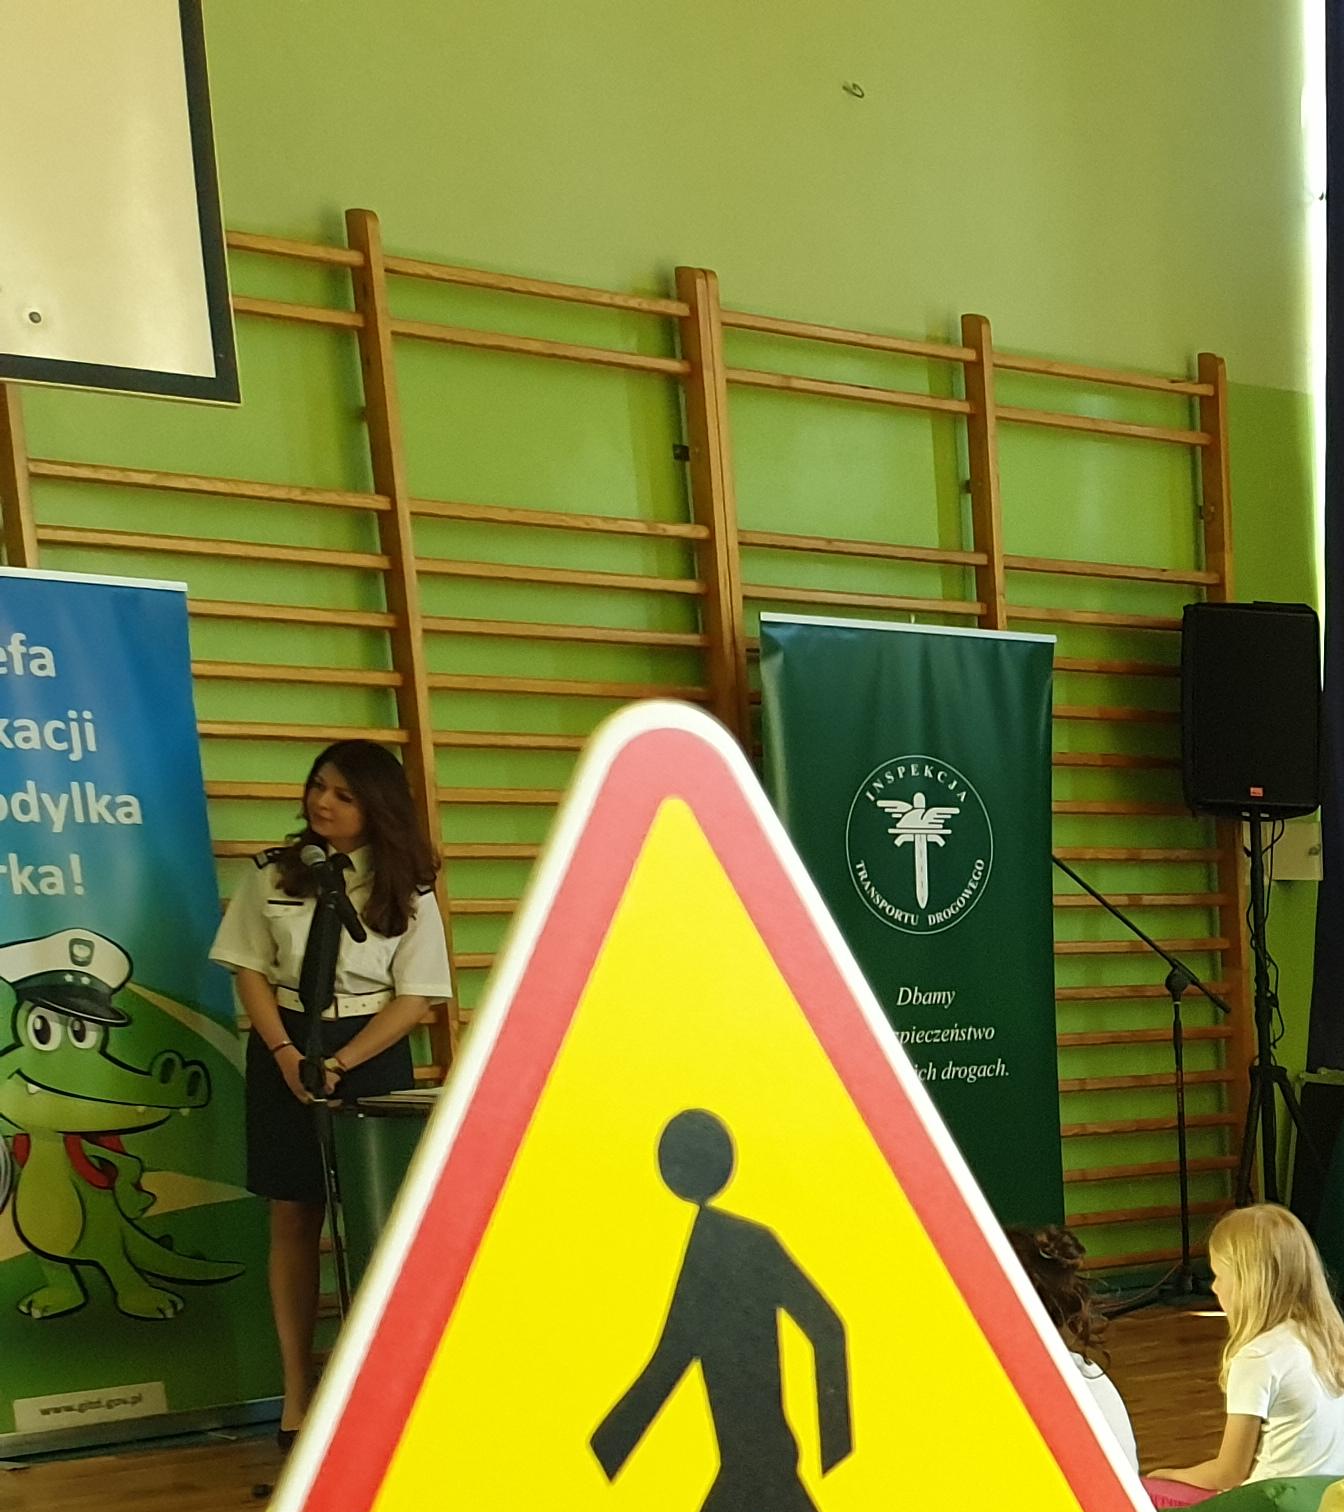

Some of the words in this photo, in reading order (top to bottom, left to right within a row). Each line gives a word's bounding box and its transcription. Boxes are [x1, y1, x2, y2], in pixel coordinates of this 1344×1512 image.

[865, 763, 968, 803] INSPEKCJA
[855, 859, 919, 926] TRANSPORTU
[927, 859, 985, 926] DROGOWEGO
[896, 986, 956, 1009] Dbamy
[941, 1058, 1010, 1083] drogach.
